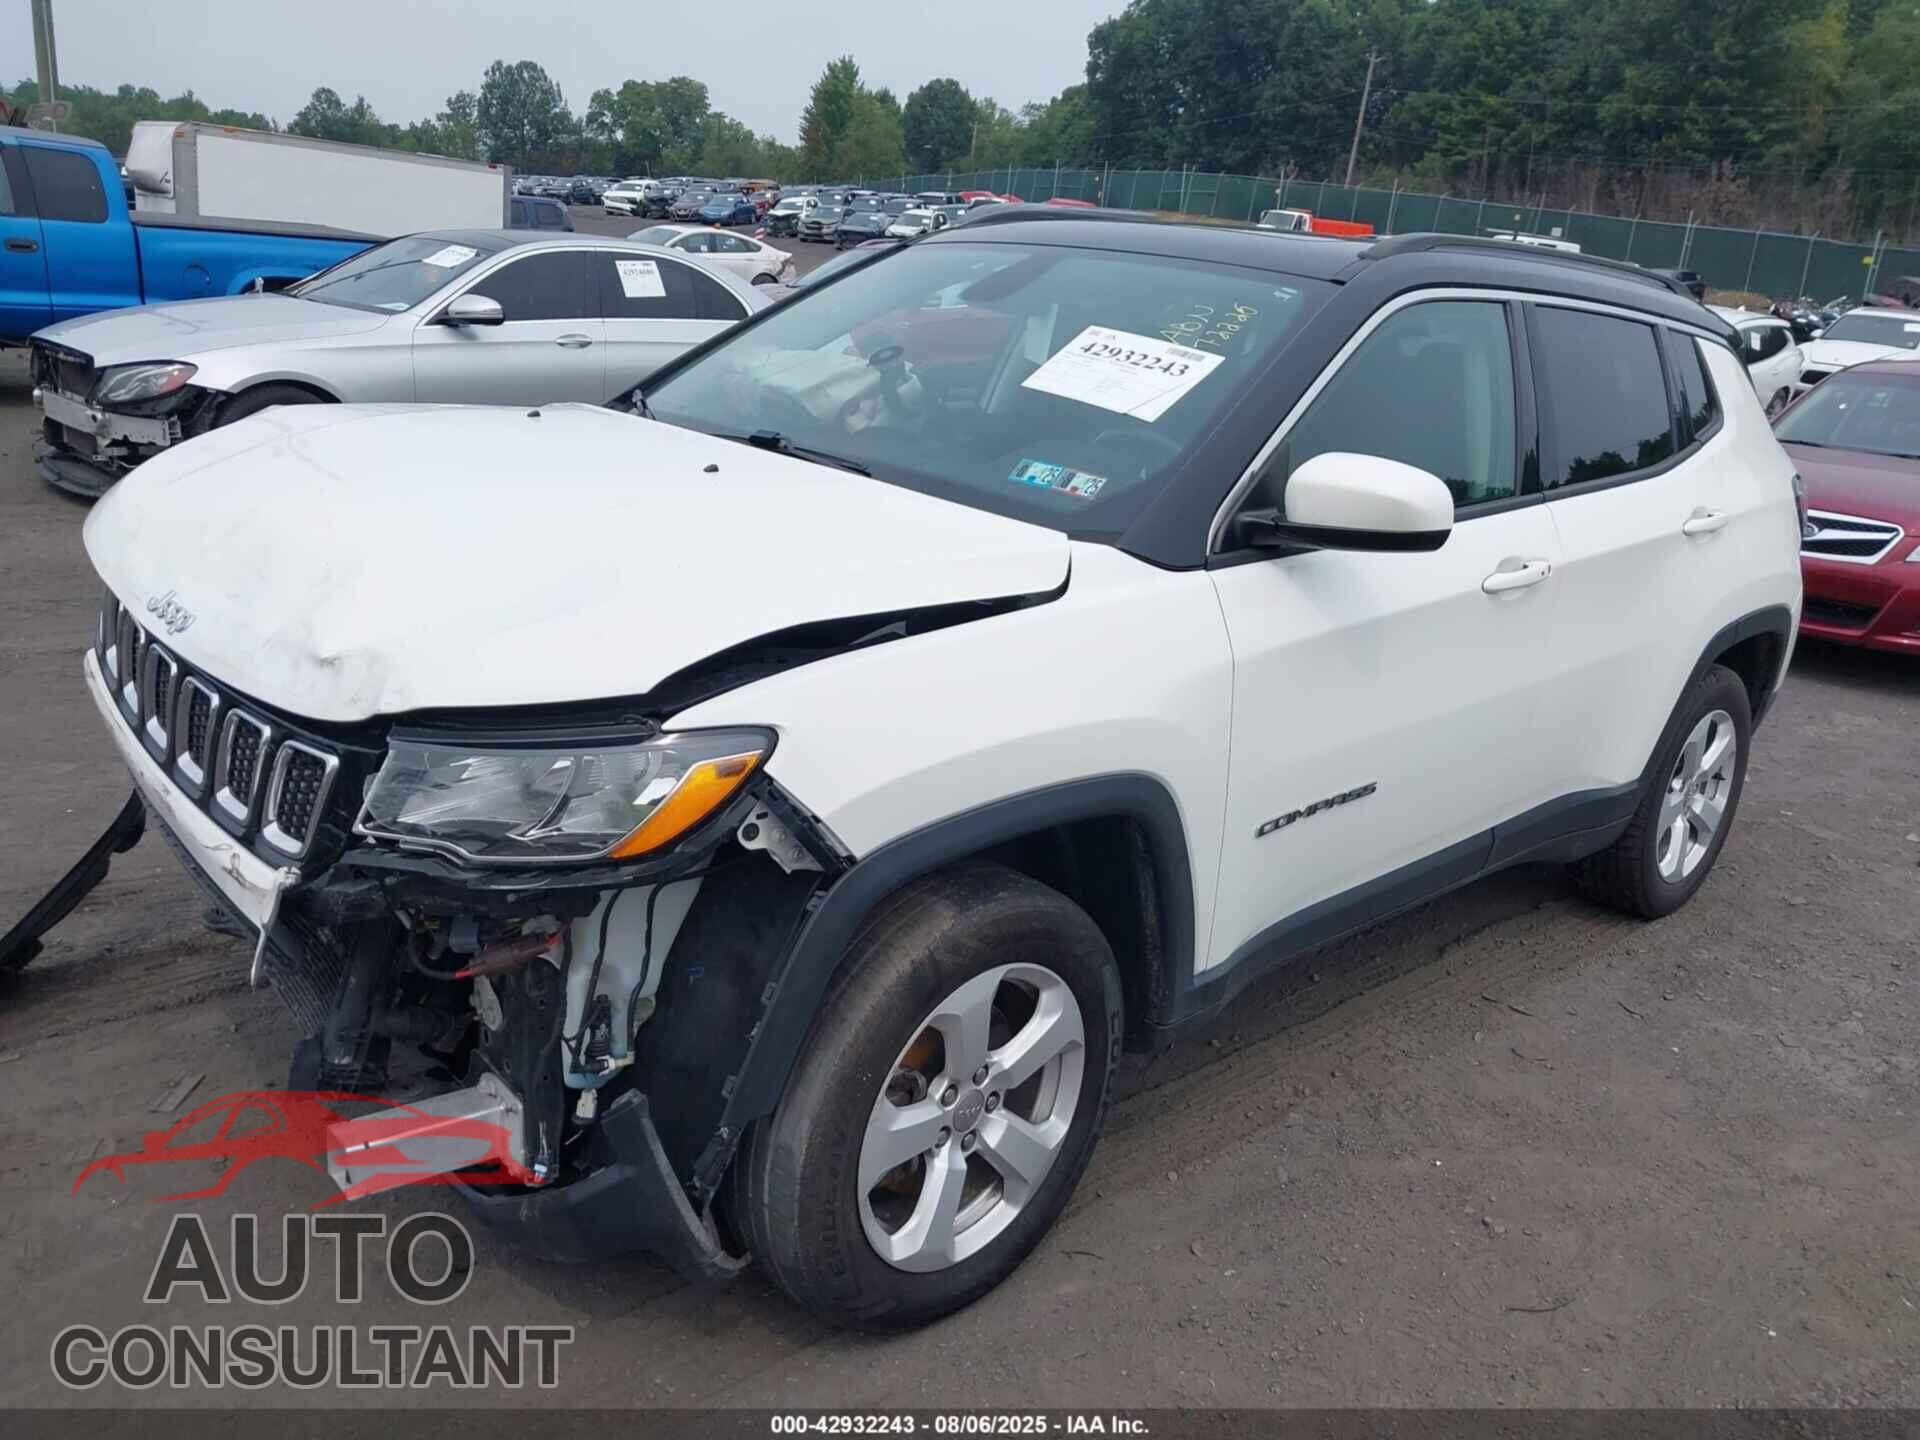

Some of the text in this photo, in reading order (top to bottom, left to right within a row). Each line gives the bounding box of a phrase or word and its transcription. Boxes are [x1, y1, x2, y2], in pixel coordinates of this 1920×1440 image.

[1080, 342, 1190, 377] 42932243
[147, 590, 196, 636] Jeep
[1256, 780, 1378, 838] COMPASS
